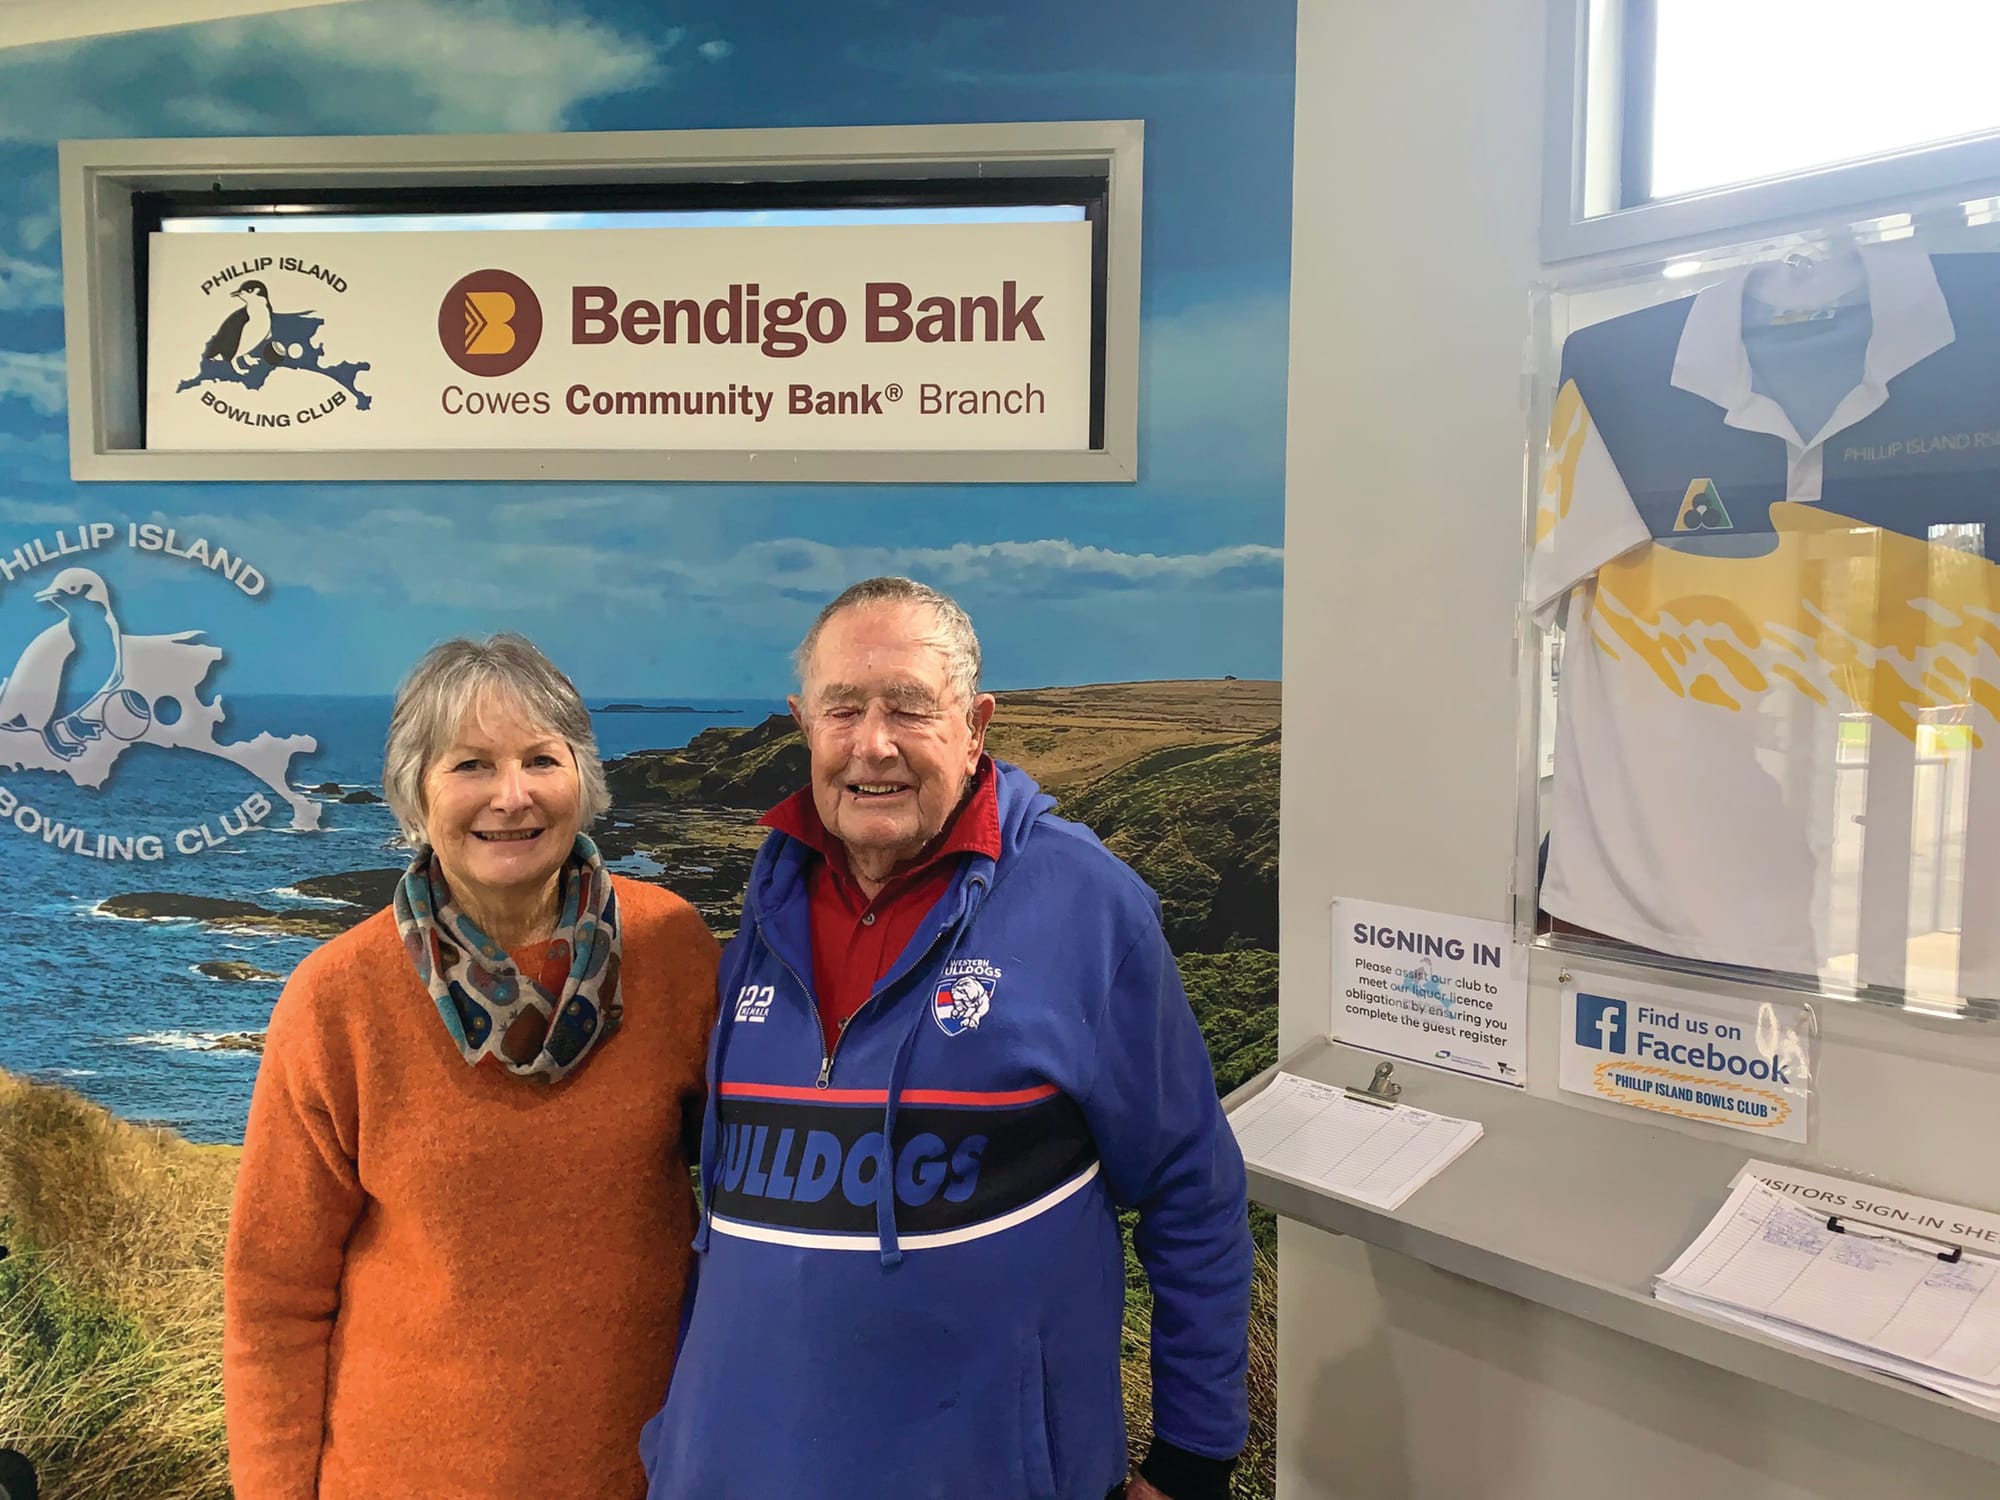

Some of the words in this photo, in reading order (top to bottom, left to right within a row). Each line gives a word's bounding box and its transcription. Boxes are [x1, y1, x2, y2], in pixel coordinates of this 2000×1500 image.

[200, 257, 273, 295] PHILLIP
[279, 257, 348, 294] ISLAND
[571, 283, 847, 358] Bendigo
[865, 281, 1046, 343] Bank
[200, 390, 290, 428] BOWLING
[297, 390, 347, 425] CLUB
[441, 385, 550, 415] Cowes
[565, 383, 773, 422] Community
[919, 382, 1045, 414] Branch
[1844, 441, 1903, 461] PHILLIP
[1906, 433, 1970, 455] ISLAND
[0, 522, 115, 581] HILLIP
[129, 523, 265, 596] ISLAND
[0, 786, 164, 861] BOWLING
[175, 792, 272, 855] CLUB
[950, 959, 990, 967] WESTERN
[1353, 923, 1464, 961] SIGNING
[1473, 943, 1501, 968] IN
[944, 966, 1002, 978] ULLDOGS
[1355, 958, 1392, 974] Please
[1395, 967, 1428, 981] assist
[1431, 974, 1452, 985] our
[1455, 977, 1481, 991] club
[1485, 983, 1498, 995] to
[1359, 976, 1388, 989] meet
[1390, 983, 1409, 993] our
[1412, 984, 1448, 1000] liquor
[1450, 992, 1493, 1010] licence
[1345, 988, 1409, 1010] obligations
[1411, 1000, 1425, 1015] by
[1429, 1006, 1481, 1027] ensuring
[1485, 1018, 1508, 1030] you
[1345, 1004, 1398, 1023] complete
[1401, 1014, 1420, 1028] the
[1423, 1021, 1456, 1037] guest
[1459, 1029, 1508, 1046] register
[1638, 1007, 1679, 1030] Find
[1686, 1020, 1708, 1035] us
[1715, 1024, 1741, 1041] on
[1637, 1032, 1790, 1085] Facebook
[1615, 1074, 1653, 1093] PHILLIP
[1655, 1082, 1693, 1102] ISLAND
[1696, 1091, 1734, 1111] BOWLS
[1737, 1100, 1768, 1118] CLUB
[714, 1124, 988, 1207] ULLDOGS
[1852, 1200, 1944, 1229] SIGN-IN
[1950, 1223, 2000, 1243] SHE
